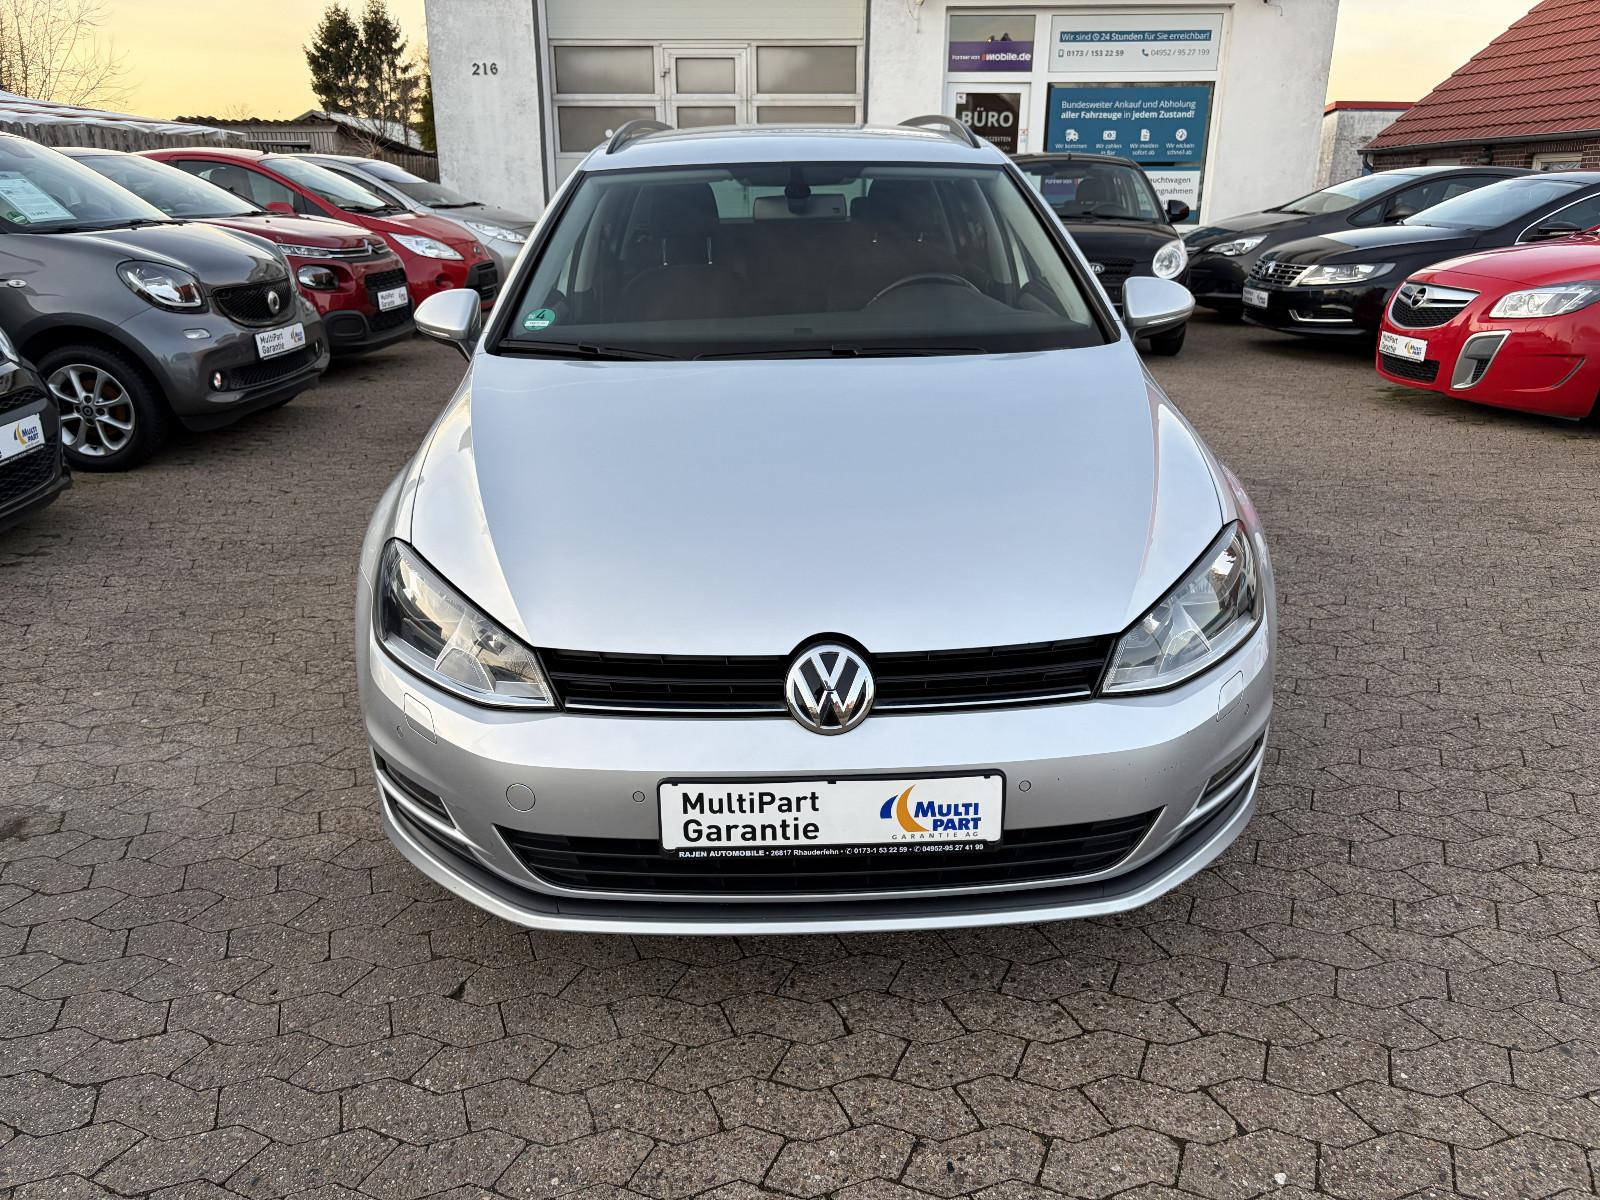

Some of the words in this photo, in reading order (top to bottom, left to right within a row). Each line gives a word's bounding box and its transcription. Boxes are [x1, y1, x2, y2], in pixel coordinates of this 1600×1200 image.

[1062, 33, 1074, 41] Wir
[1075, 32, 1091, 41] sind
[1111, 32, 1143, 41] Stunden
[1144, 32, 1155, 40] für
[1157, 32, 1168, 40] Sie
[1169, 31, 1210, 40] erreichbar!
[986, 52, 1032, 61] mobile.de
[472, 62, 498, 76] 216
[1061, 101, 1113, 109] Bundesweiter
[1114, 100, 1141, 109] Ankauf
[1142, 100, 1159, 108] und
[1159, 100, 1197, 110] Abholung
[961, 107, 1014, 127] BÜRO
[1061, 111, 1080, 119] aller
[1080, 111, 1122, 120] Fahrzeuge
[1131, 110, 1158, 120] jedem
[1159, 110, 1195, 119] Zustand!
[682, 791, 820, 815] MultiPart
[914, 800, 980, 818] MULTI
[682, 816, 820, 842] Garantie
[932, 817, 981, 832] PART
[891, 832, 958, 840] GARANTIE
[678, 850, 707, 858] RAJEN
[709, 849, 765, 857] AUTOMOBILE
[770, 849, 792, 857] 26817
[793, 848, 839, 856] Rhauderfehn
